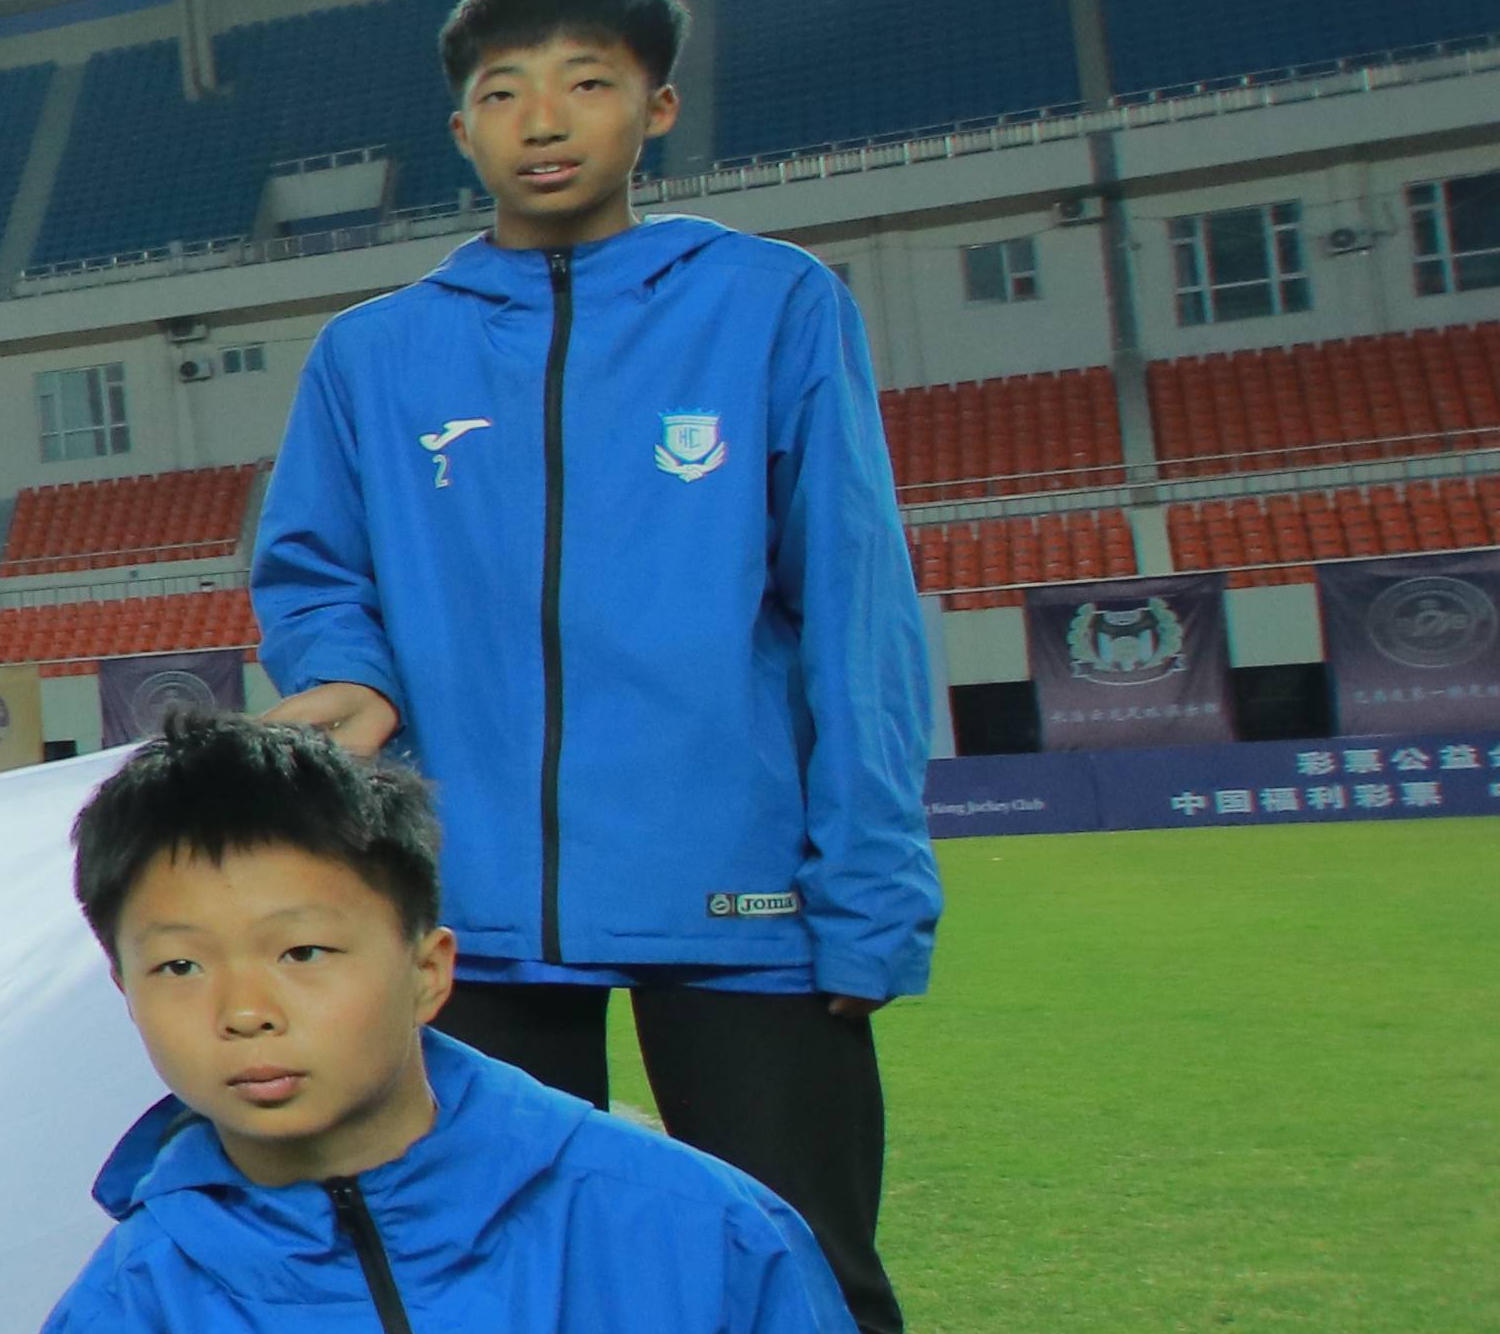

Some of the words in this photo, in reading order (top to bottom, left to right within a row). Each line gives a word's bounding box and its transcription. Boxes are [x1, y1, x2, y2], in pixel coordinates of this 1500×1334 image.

[431, 453, 449, 489] 2
[1012, 797, 1044, 812] Club
[1170, 781, 1442, 816] 中国福利彩票
